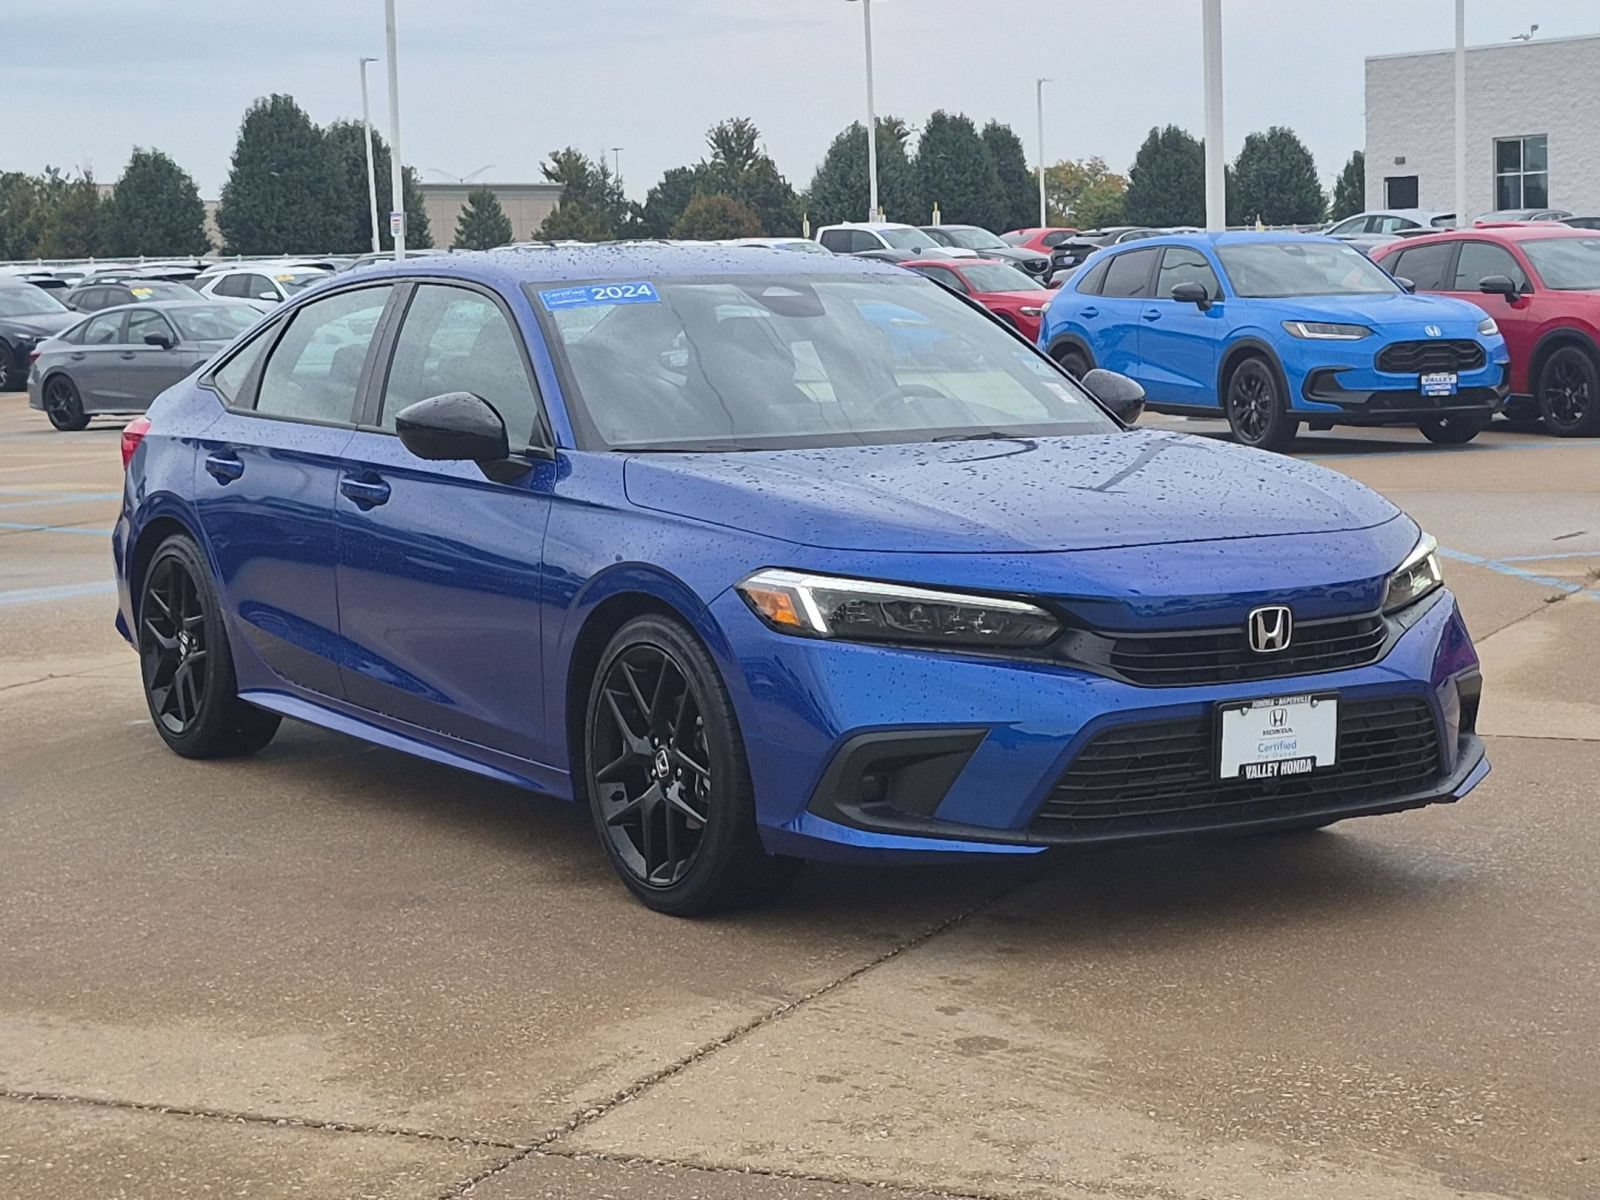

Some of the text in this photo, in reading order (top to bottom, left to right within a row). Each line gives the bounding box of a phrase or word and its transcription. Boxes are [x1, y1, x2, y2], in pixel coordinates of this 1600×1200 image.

[591, 284, 653, 300] 2024
[1262, 727, 1294, 736] HONDA
[1257, 740, 1297, 753] Certified
[1245, 759, 1312, 780] VALLEY HONDA
